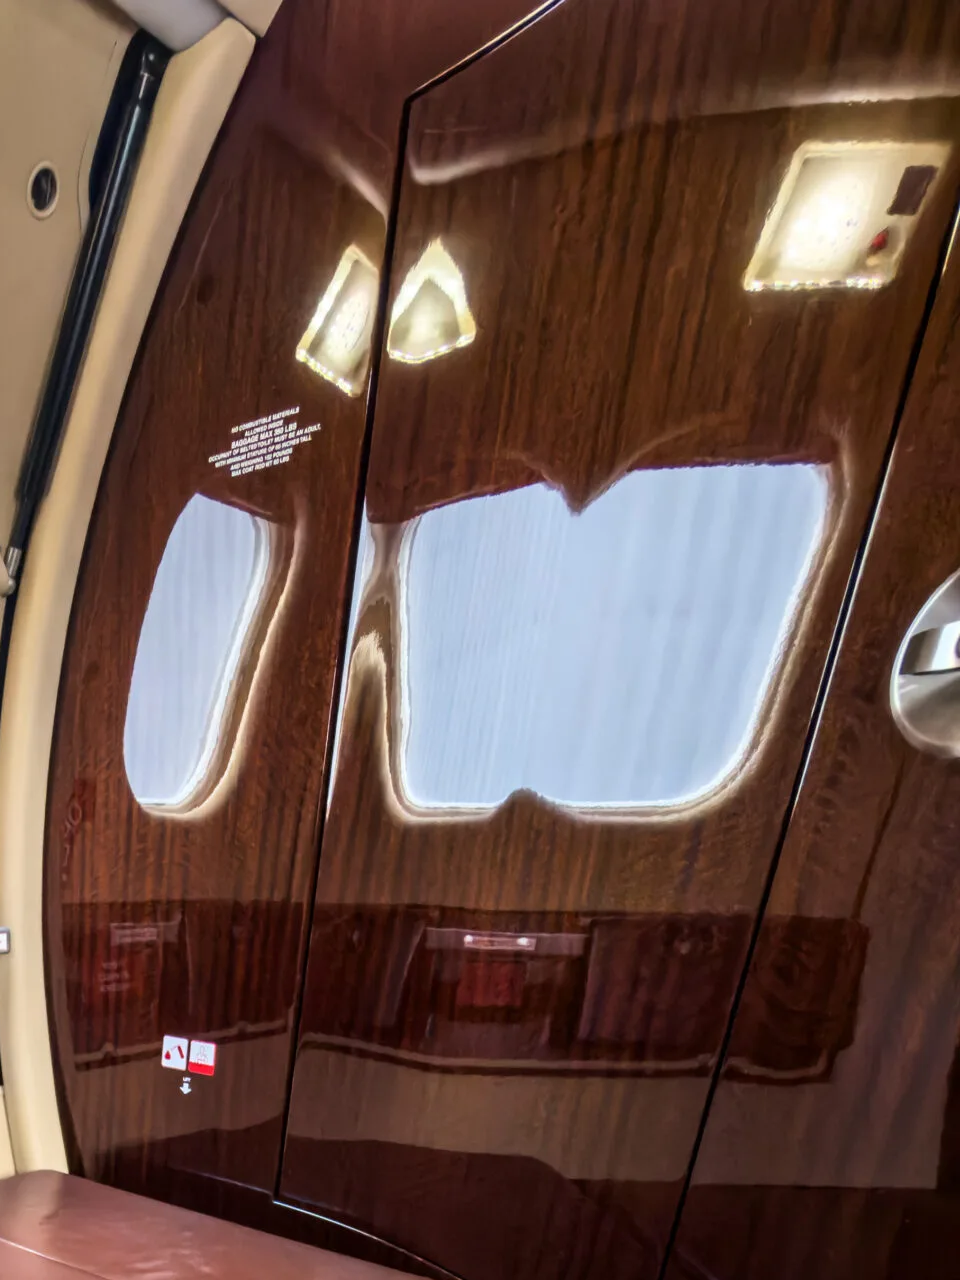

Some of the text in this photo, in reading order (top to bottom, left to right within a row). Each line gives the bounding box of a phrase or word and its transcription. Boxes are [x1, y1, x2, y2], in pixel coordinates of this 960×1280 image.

[231, 435, 259, 448] BAGGAGE
[260, 431, 273, 440] MAX
[285, 423, 297, 433] LBS
[245, 425, 267, 436] ALLOWED
